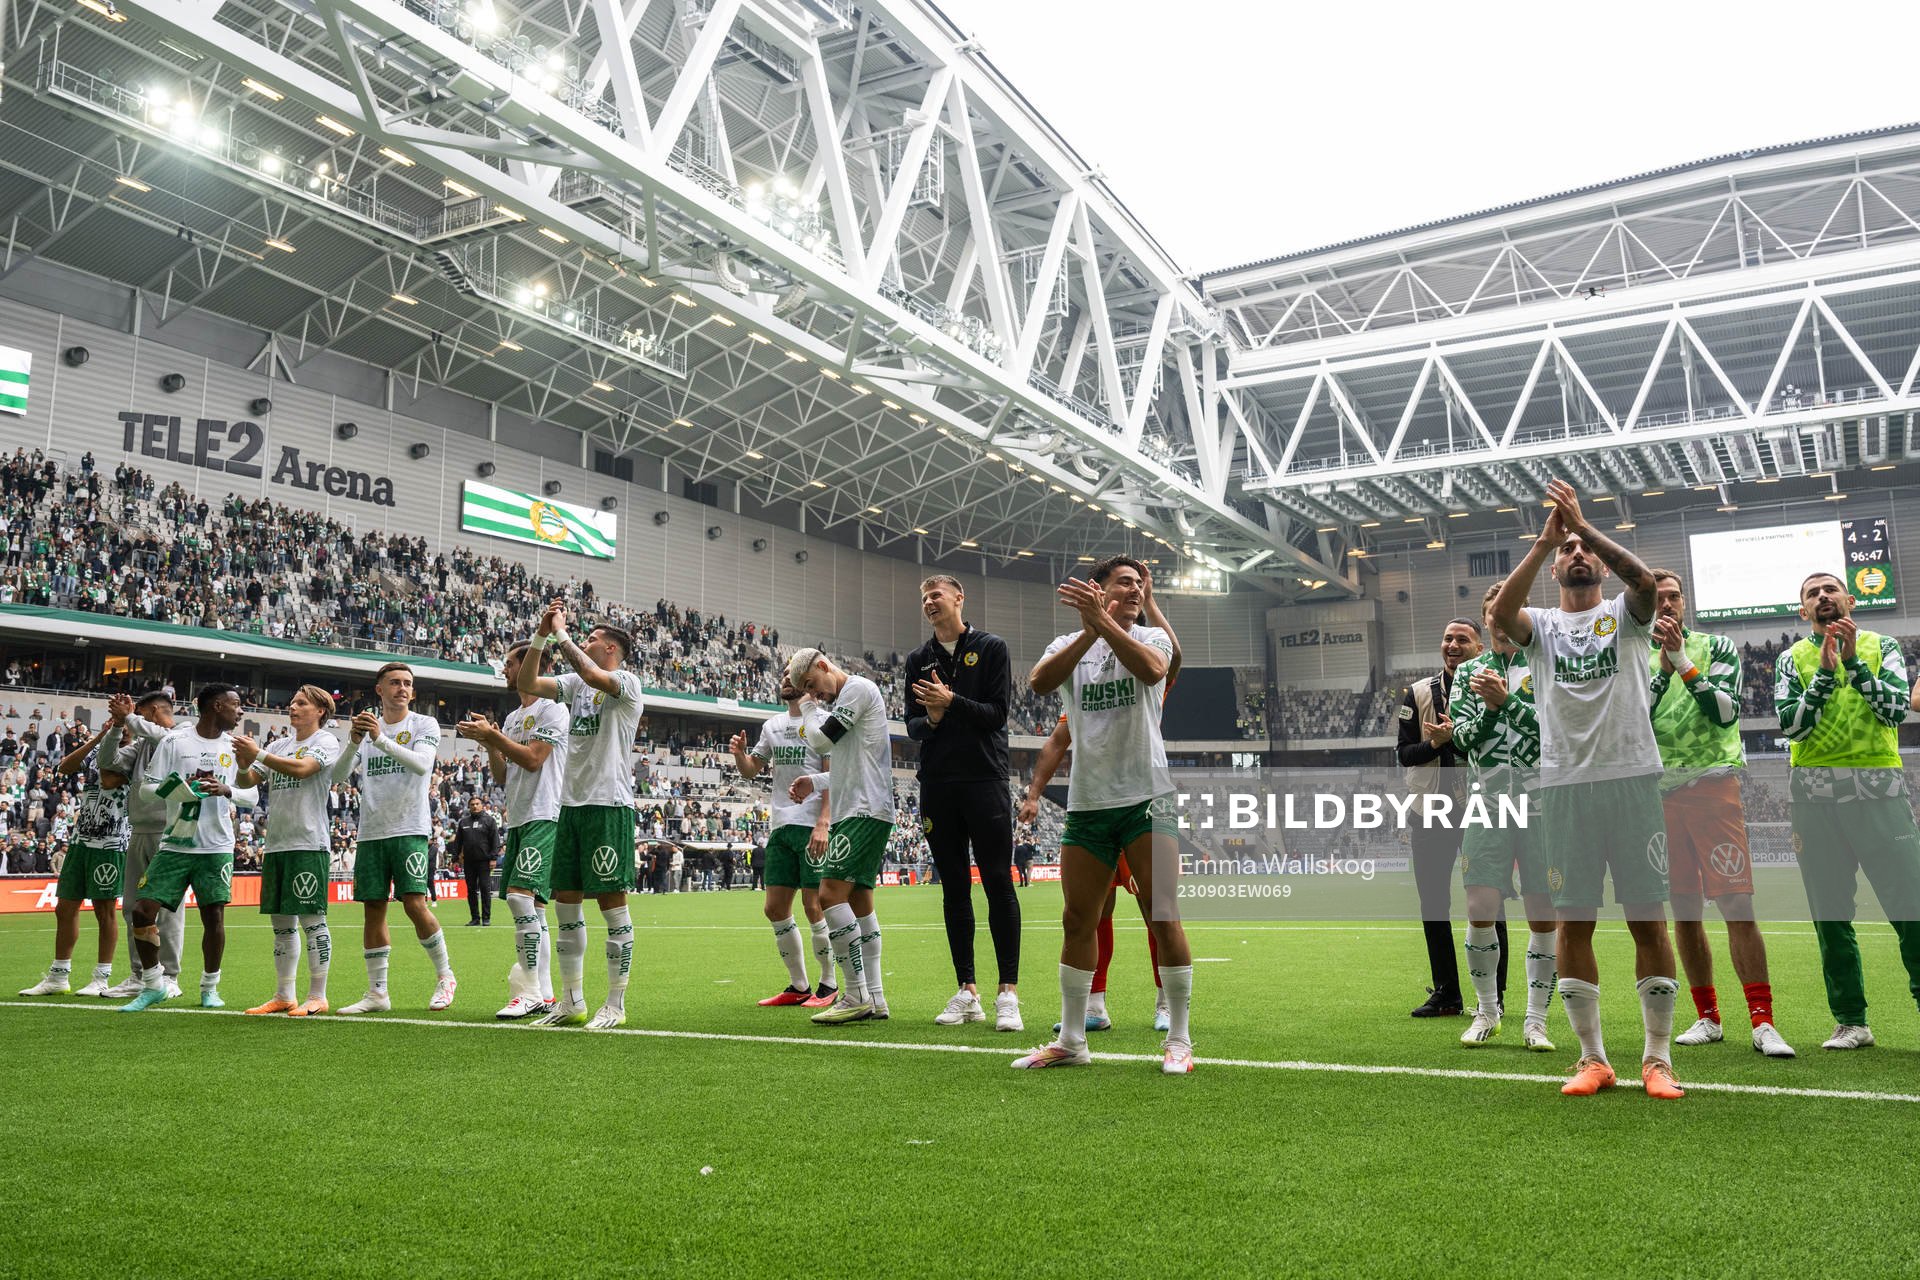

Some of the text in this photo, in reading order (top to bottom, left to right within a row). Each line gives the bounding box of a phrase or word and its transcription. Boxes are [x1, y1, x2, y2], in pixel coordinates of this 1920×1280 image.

[118, 411, 396, 507] TELE2 Arena
[1847, 531, 1857, 543] 4
[1872, 529, 1882, 541] 2
[1851, 549, 1883, 562] 96:47
[1280, 629, 1364, 648] TELE2 Arena
[1555, 647, 1617, 673] HUSKI
[1554, 665, 1619, 683] CHOCOLATE
[1082, 677, 1136, 703] HUSKI
[1081, 696, 1137, 712] CHOCOLATE
[773, 746, 807, 759] HUSKI
[367, 766, 406, 777] CHOCOLATE
[1752, 852, 1797, 862] PROJOB
